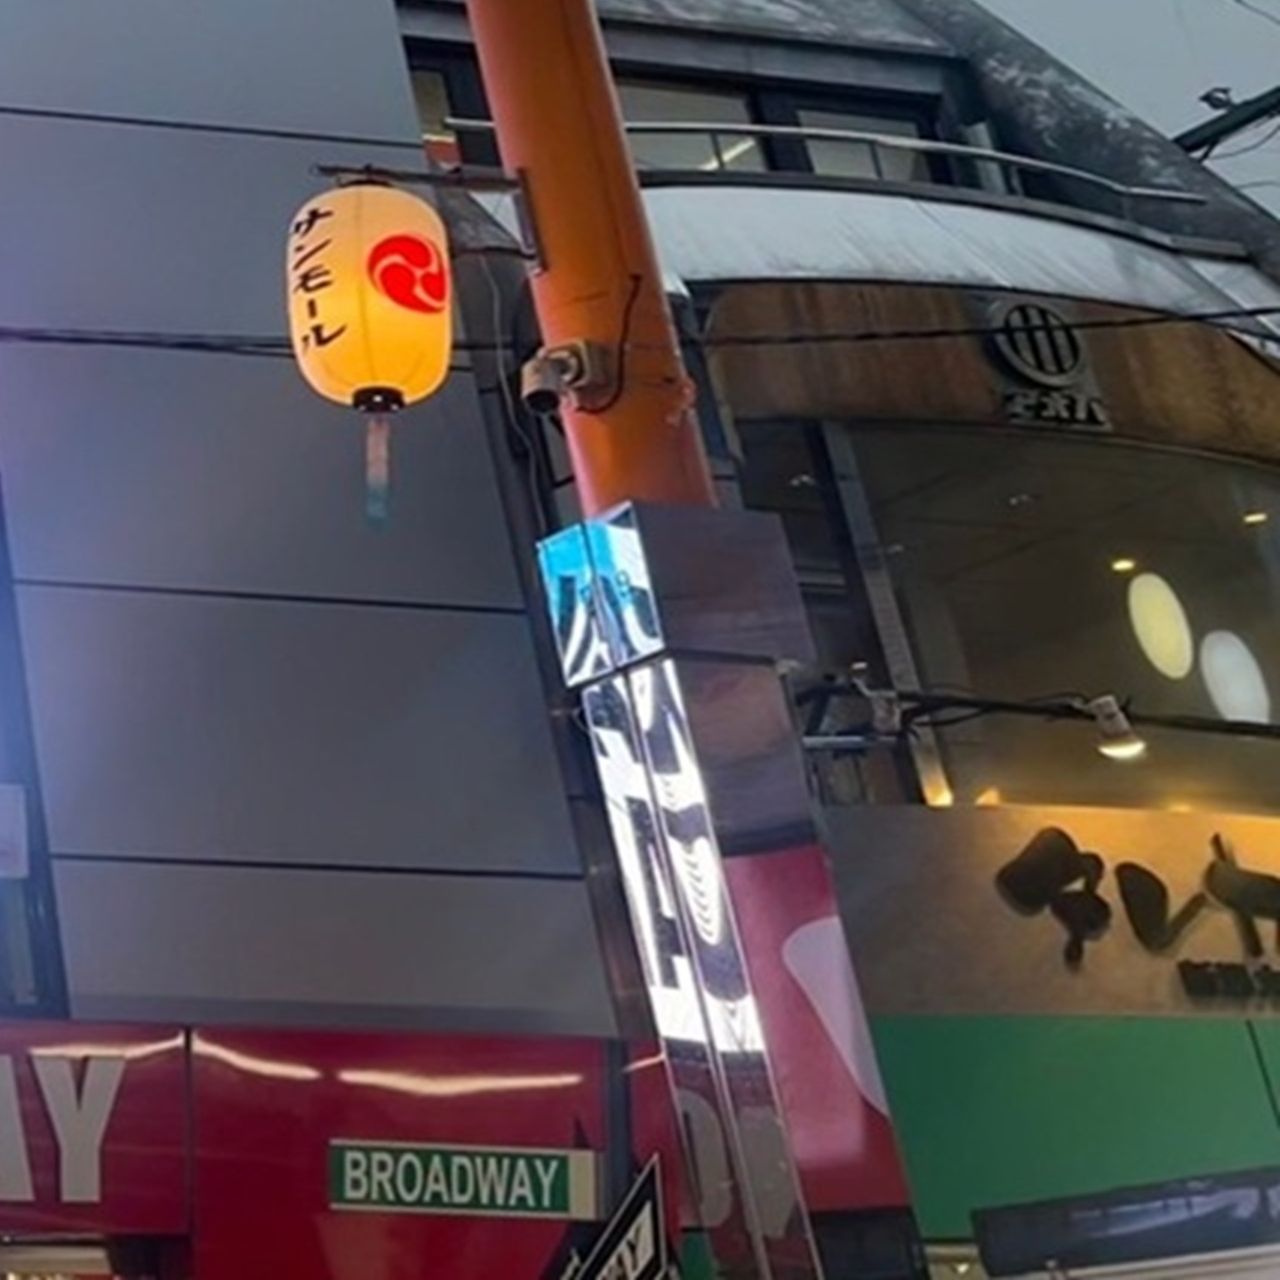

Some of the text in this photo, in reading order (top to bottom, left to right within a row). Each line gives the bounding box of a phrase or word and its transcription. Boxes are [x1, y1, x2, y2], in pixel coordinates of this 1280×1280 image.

[291, 207, 346, 354] サンモール
[343, 1150, 560, 1209] BROADWAY
